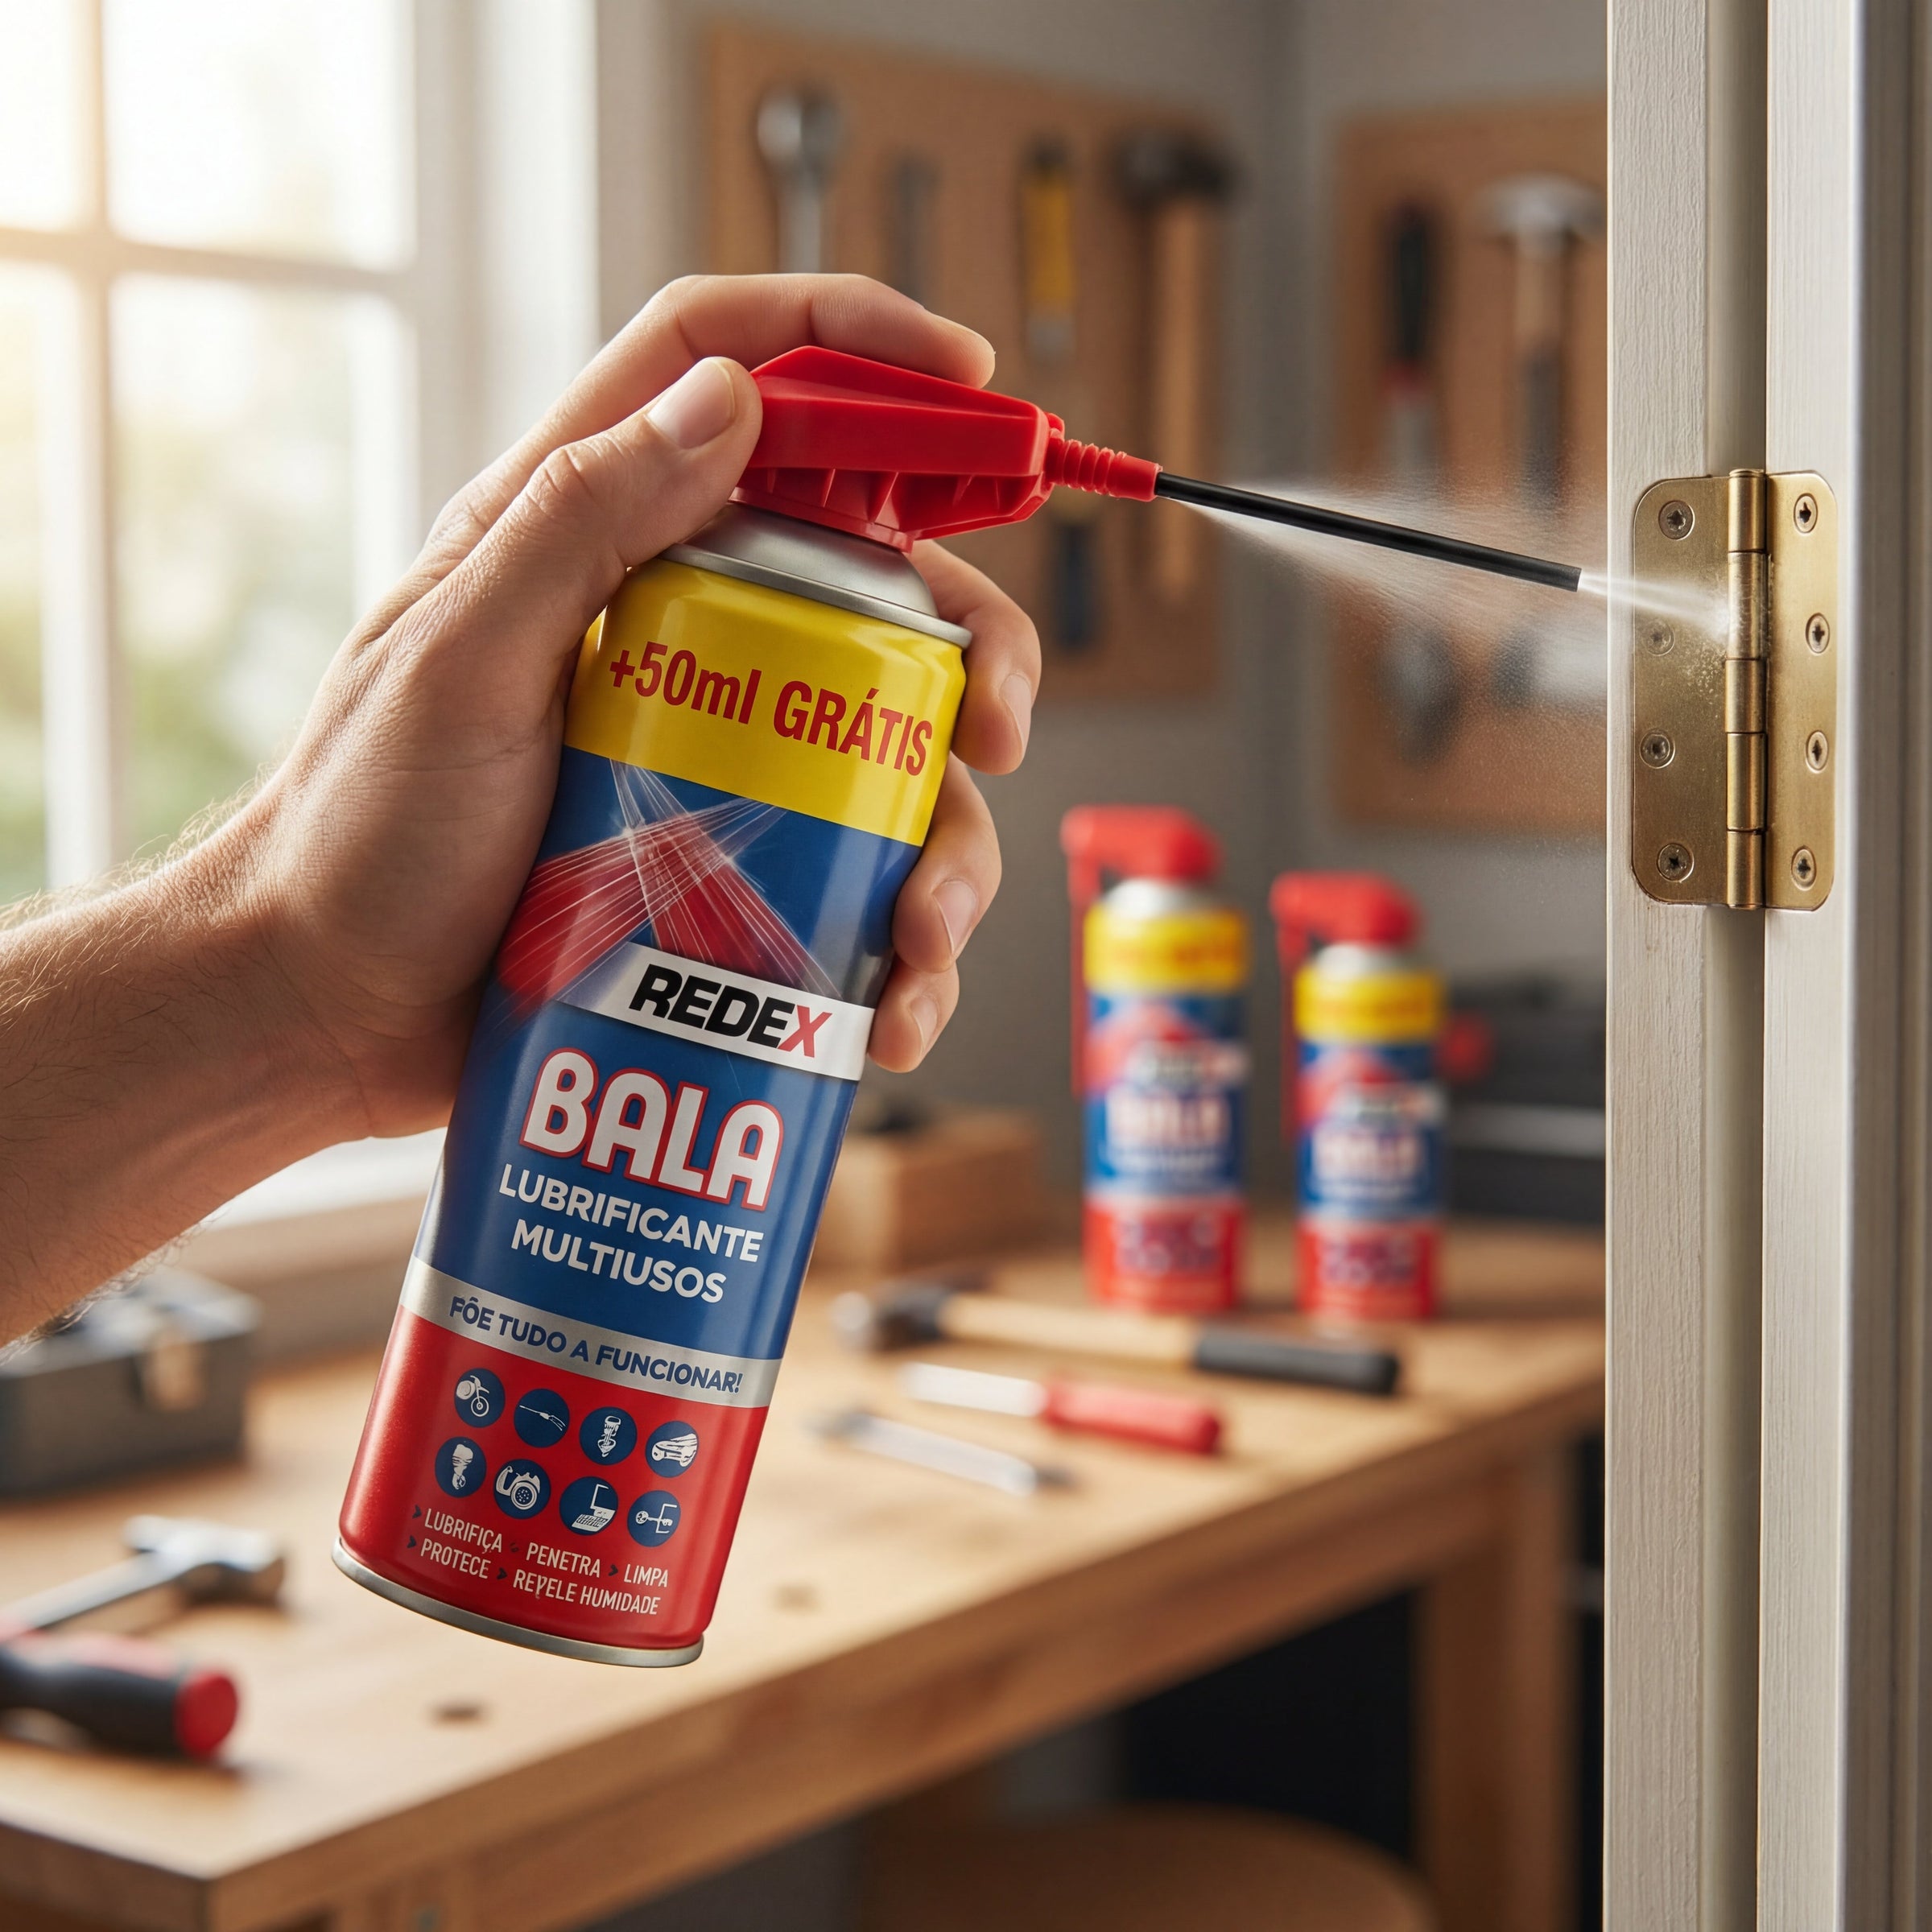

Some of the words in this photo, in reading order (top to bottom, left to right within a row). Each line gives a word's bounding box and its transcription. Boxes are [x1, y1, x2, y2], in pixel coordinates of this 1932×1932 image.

[609, 641, 762, 724] +50ml
[773, 680, 933, 776] GRÁTIS
[629, 964, 832, 1058] REDEX
[518, 1047, 784, 1212] BALA
[498, 1163, 764, 1262] LUBRIFICANTE
[511, 1219, 727, 1303] MULTIUSOS
[498, 1313, 567, 1353] TUDO
[570, 1340, 588, 1362] A
[595, 1344, 744, 1394] FUNCIONAR!
[420, 1538, 492, 1579] PROTECE
[580, 1587, 661, 1615] HUMIDADE
[526, 1542, 601, 1578] PENETRA
[624, 1563, 669, 1587] LIMPA
